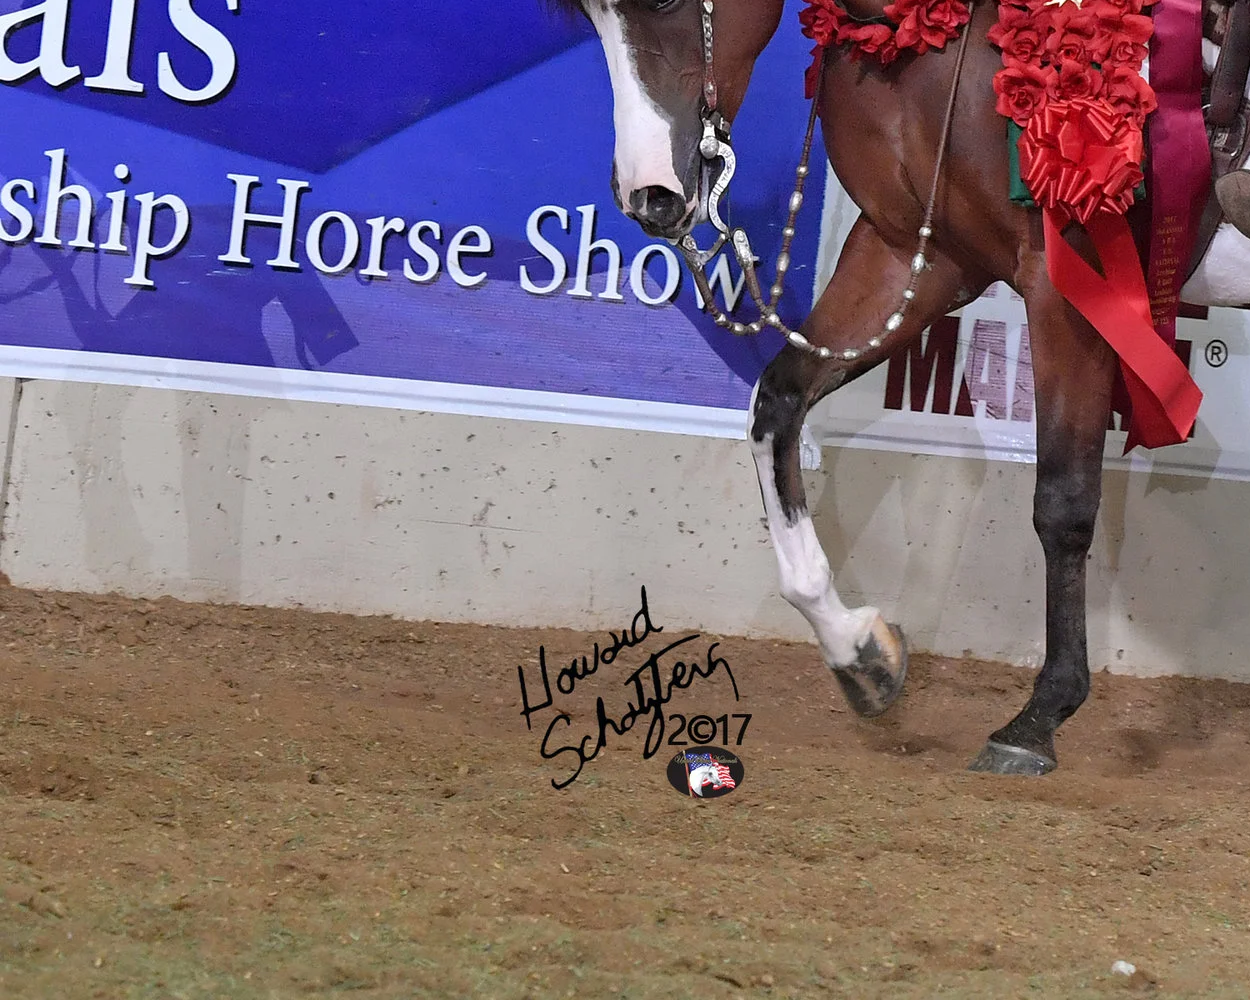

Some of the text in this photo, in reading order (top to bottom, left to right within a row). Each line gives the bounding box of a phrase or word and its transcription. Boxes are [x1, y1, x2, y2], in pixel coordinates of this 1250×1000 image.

[0, 148, 760, 312] ship Horse Show
